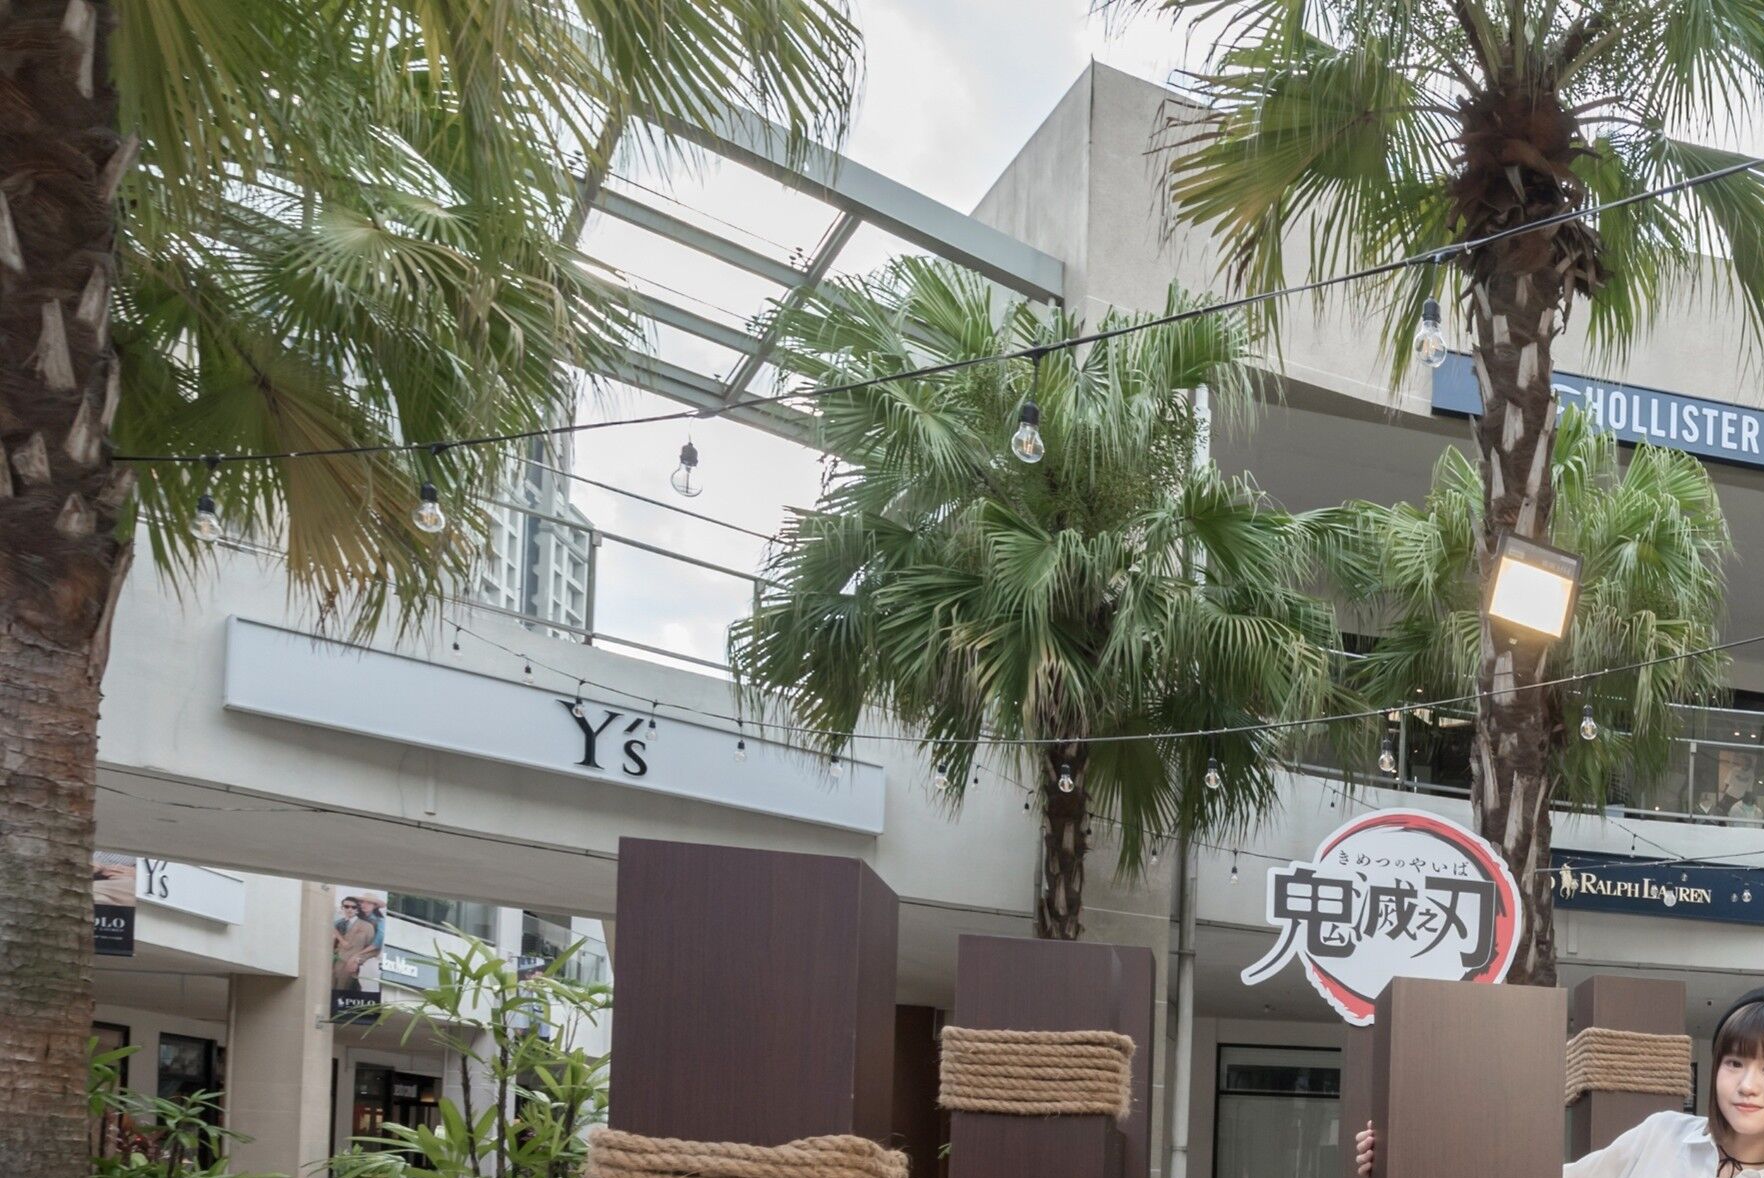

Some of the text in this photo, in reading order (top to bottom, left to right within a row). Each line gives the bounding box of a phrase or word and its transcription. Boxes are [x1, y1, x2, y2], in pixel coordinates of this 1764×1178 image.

[1585, 386, 1760, 454] HOLLISTER
[555, 699, 648, 776] Y's
[1338, 850, 1470, 877] きめつのやいば
[1580, 872, 1640, 898] RALPH
